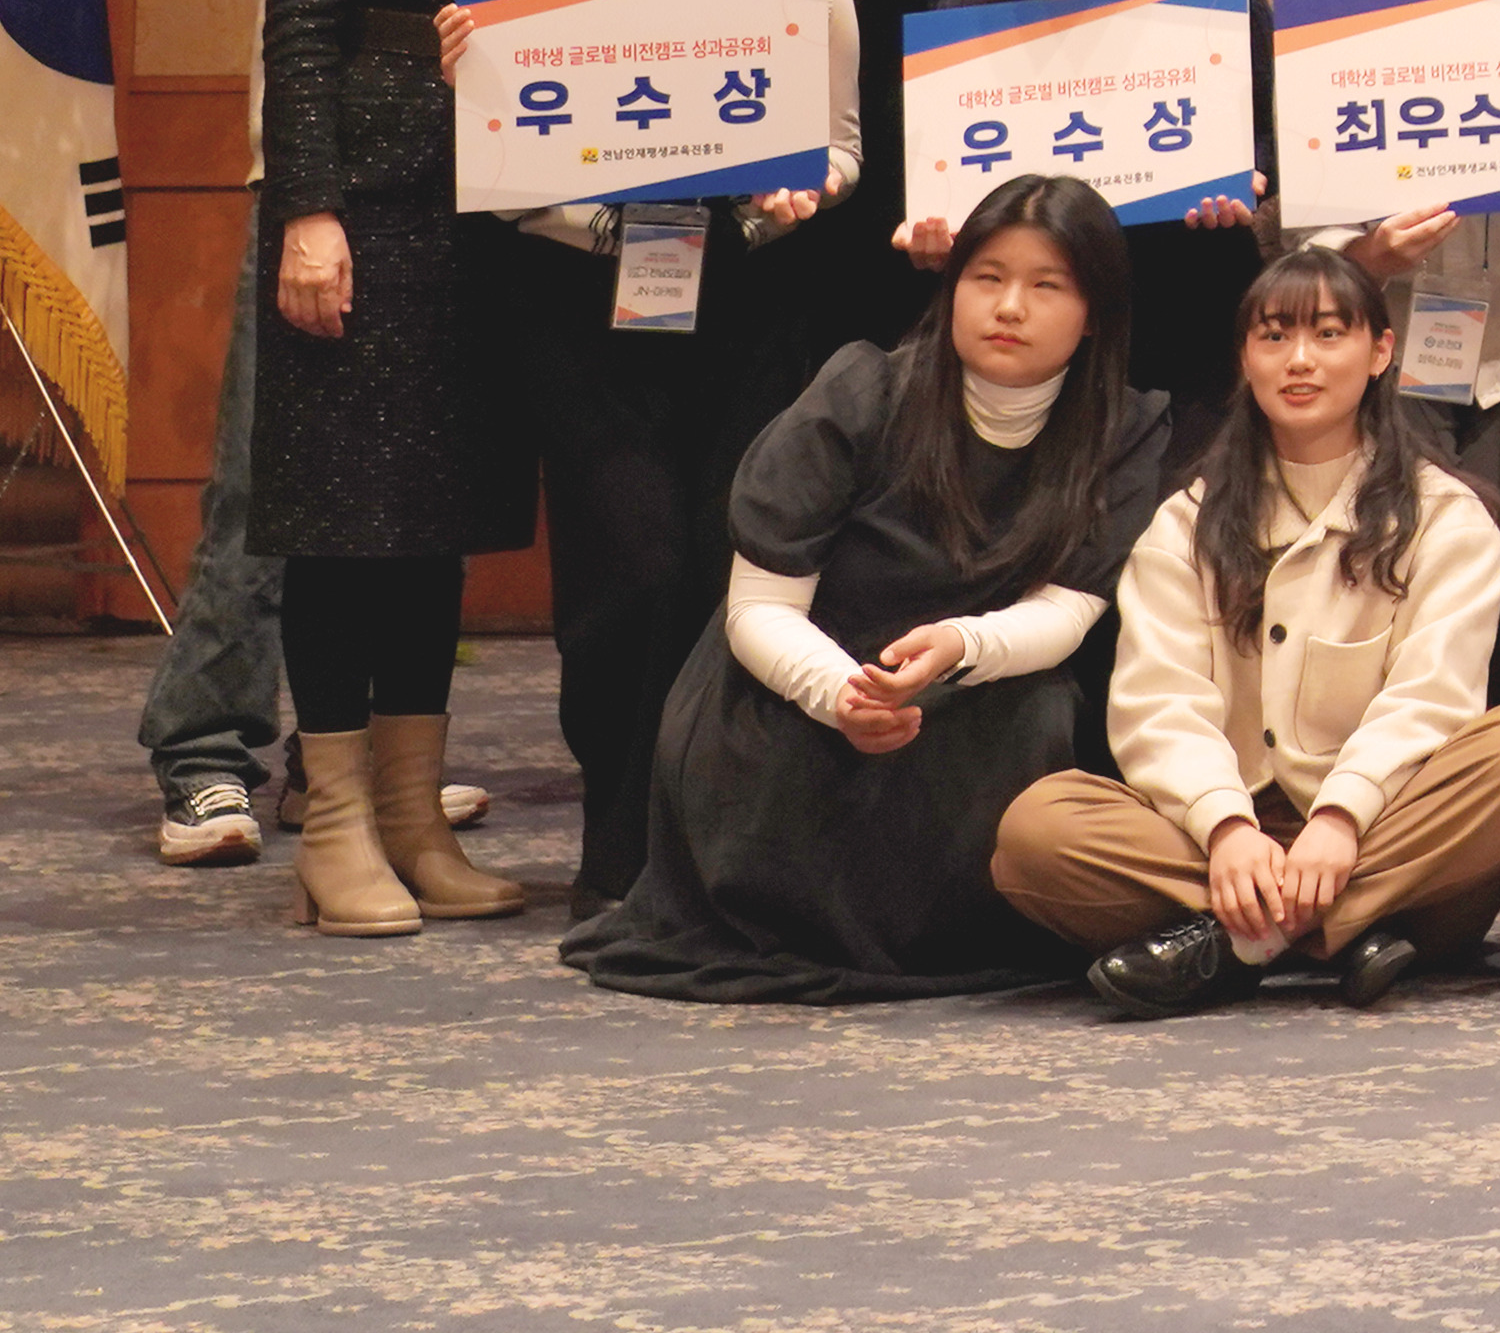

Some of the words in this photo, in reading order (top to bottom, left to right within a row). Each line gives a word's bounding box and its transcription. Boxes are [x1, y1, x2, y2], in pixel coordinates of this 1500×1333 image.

[515, 47, 563, 68] 대학생
[569, 44, 616, 65] 글로벌
[623, 42, 686, 62] 비전캠프
[692, 36, 771, 58] 성과공유회
[959, 88, 1003, 109] 대학생
[1008, 82, 1052, 104] 글로벌
[1058, 76, 1116, 98] 비전캠프
[1122, 66, 1196, 91] 성과공유회
[1331, 69, 1376, 88] 대학생
[1381, 65, 1425, 86] 글로벌
[1431, 62, 1490, 82] 비전캠프
[602, 143, 723, 161] 전남인재평생교육진흥원
